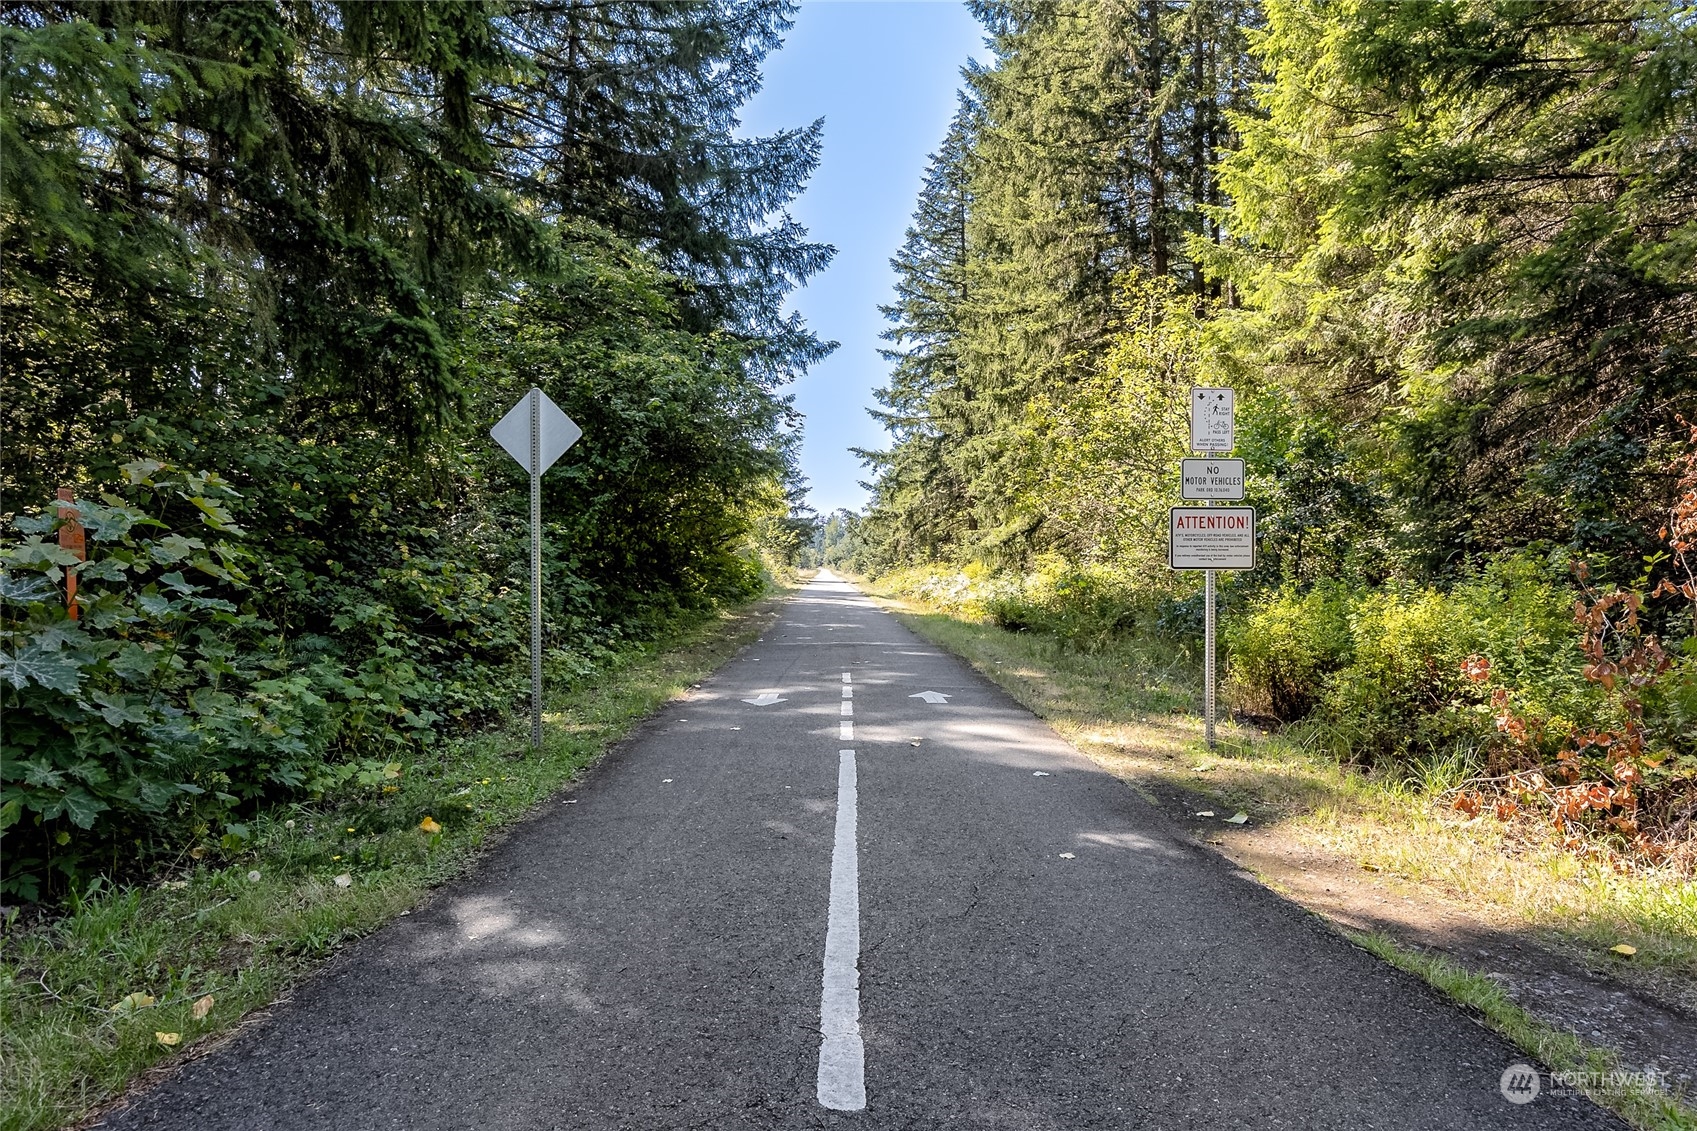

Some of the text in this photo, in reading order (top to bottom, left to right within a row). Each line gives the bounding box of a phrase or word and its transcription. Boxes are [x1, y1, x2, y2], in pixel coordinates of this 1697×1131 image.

[1206, 466, 1220, 474] NO
[1185, 476, 1241, 485] MOTOR VEHICLES
[1176, 516, 1248, 529] ATTENTION!
